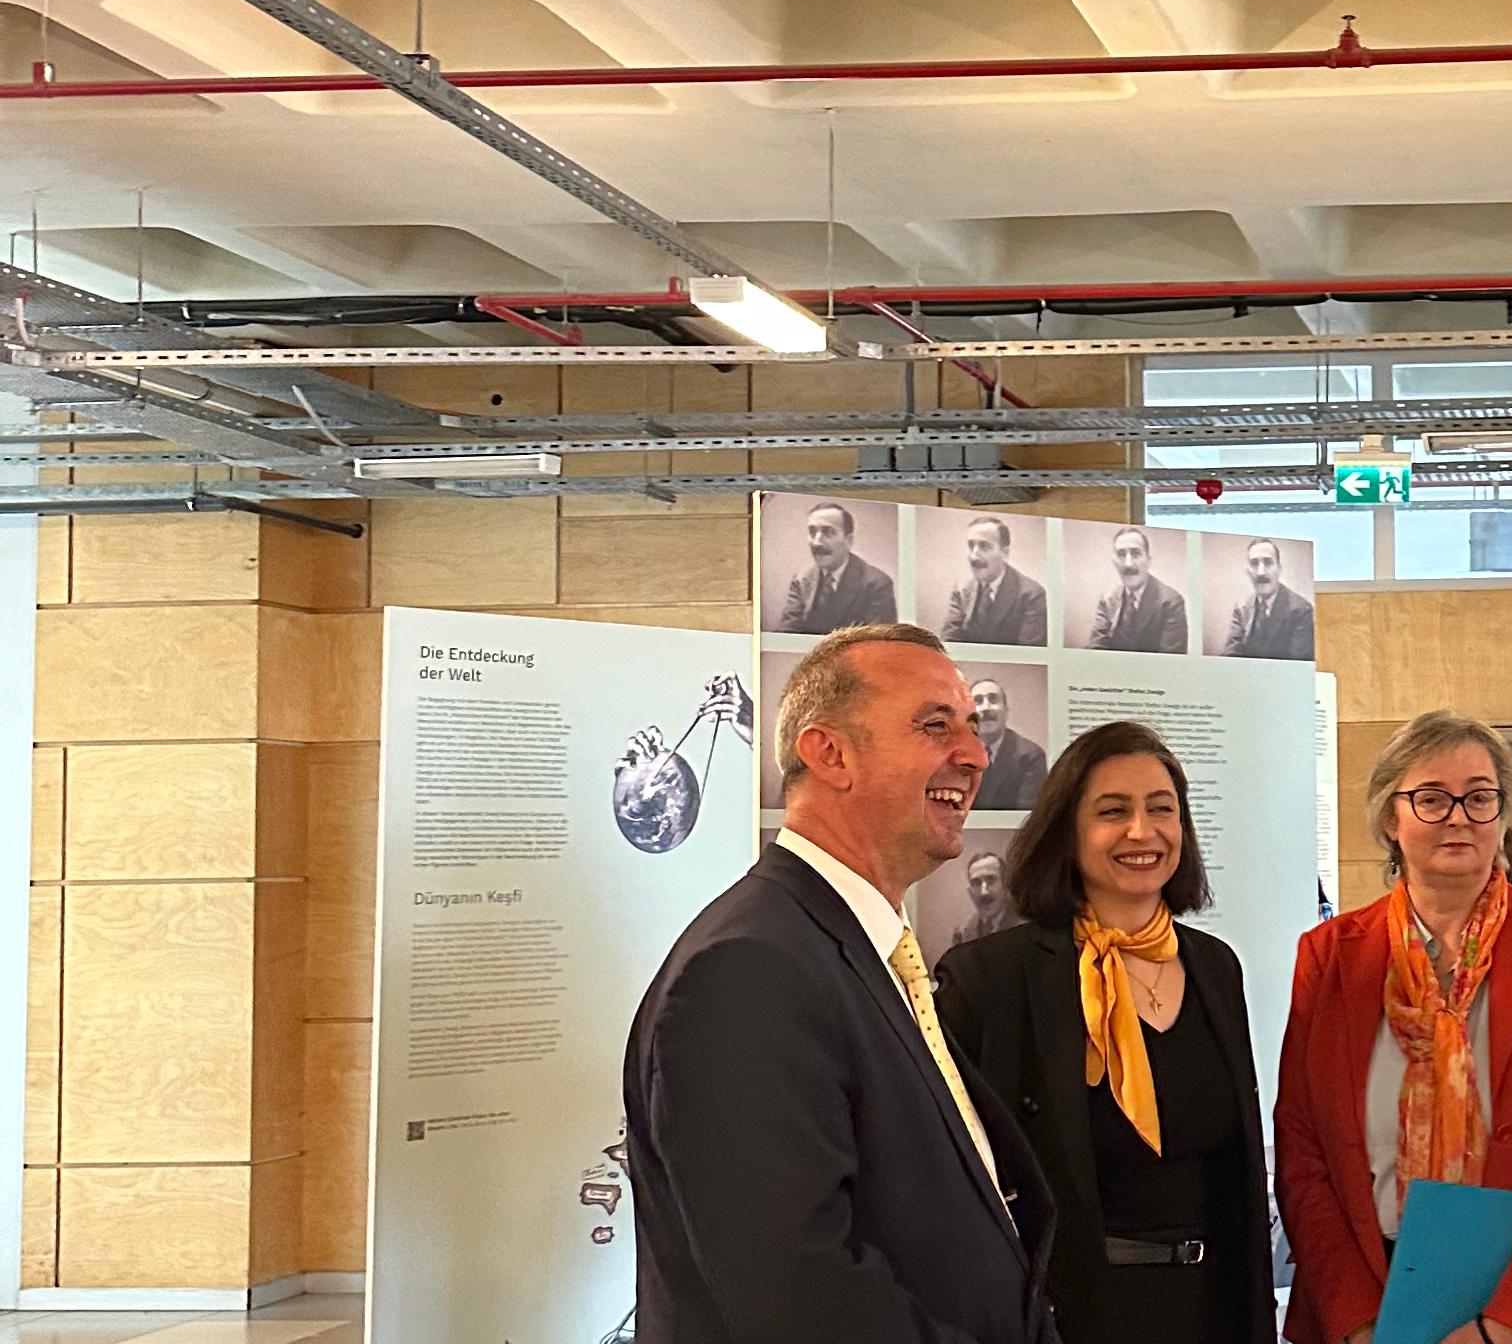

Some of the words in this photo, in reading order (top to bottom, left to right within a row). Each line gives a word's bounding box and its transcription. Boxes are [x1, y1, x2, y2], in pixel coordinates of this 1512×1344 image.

[420, 645, 444, 659] Die
[449, 647, 535, 668] Entdeckung
[419, 666, 444, 679] der
[448, 668, 482, 682] Welt
[414, 892, 482, 908] Dünyanın
[487, 890, 522, 905] Keşfi
